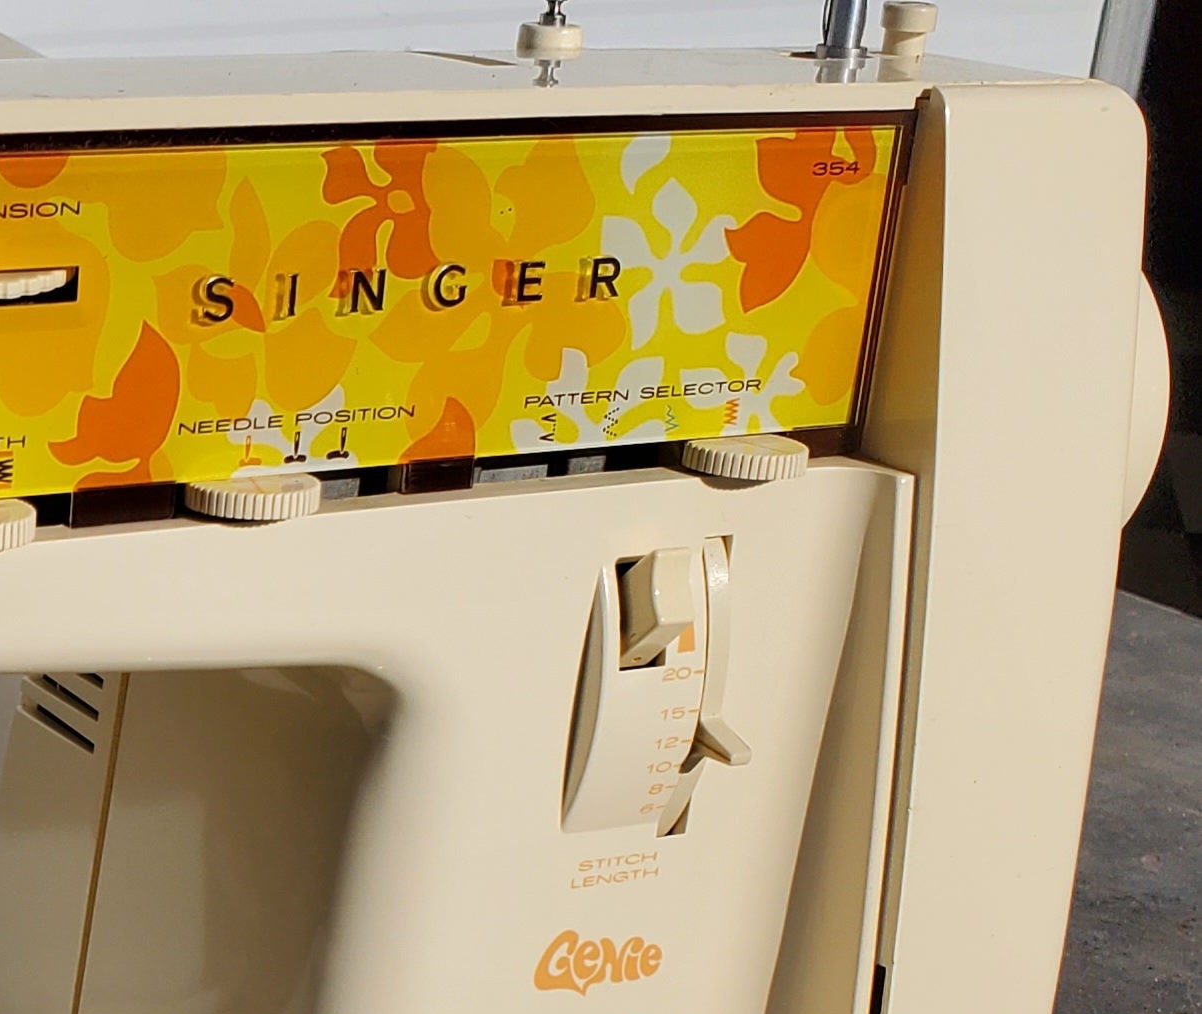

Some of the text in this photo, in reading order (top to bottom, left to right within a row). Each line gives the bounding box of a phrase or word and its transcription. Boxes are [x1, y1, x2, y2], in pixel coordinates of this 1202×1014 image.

[812, 161, 860, 176] 354
[196, 256, 622, 322] SINGER
[524, 379, 762, 408] PATTERN SELECTOR
[178, 405, 416, 436] NEEDLE POSITION
[662, 667, 691, 682] 20
[660, 708, 686, 720] 15
[655, 737, 678, 750] 12
[646, 761, 672, 774] 10
[648, 784, 664, 795] 8
[639, 804, 654, 815] 6
[578, 852, 658, 871] STITCH
[570, 868, 660, 889] LENGTH
